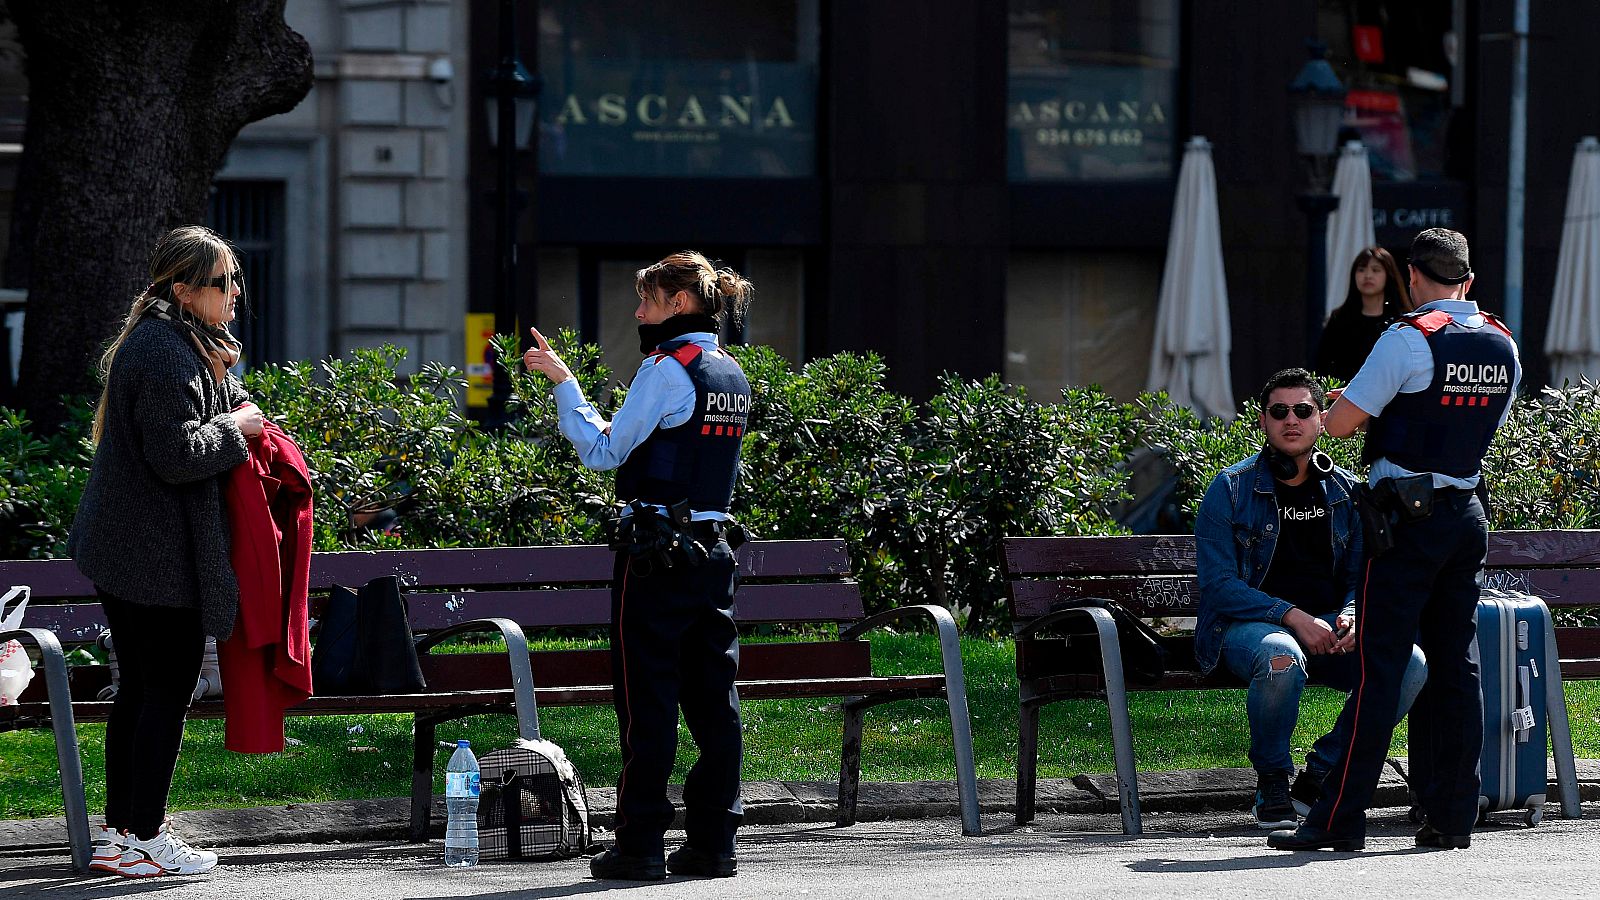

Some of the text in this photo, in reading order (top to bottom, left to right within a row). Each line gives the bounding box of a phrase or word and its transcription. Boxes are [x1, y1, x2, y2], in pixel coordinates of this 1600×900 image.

[557, 94, 795, 126] ASCANA
[1013, 101, 1166, 124] ASCANA
[1446, 363, 1508, 384] POLICIA
[1443, 384, 1508, 395] mossos d'esquadra
[704, 414, 729, 423] mossos
